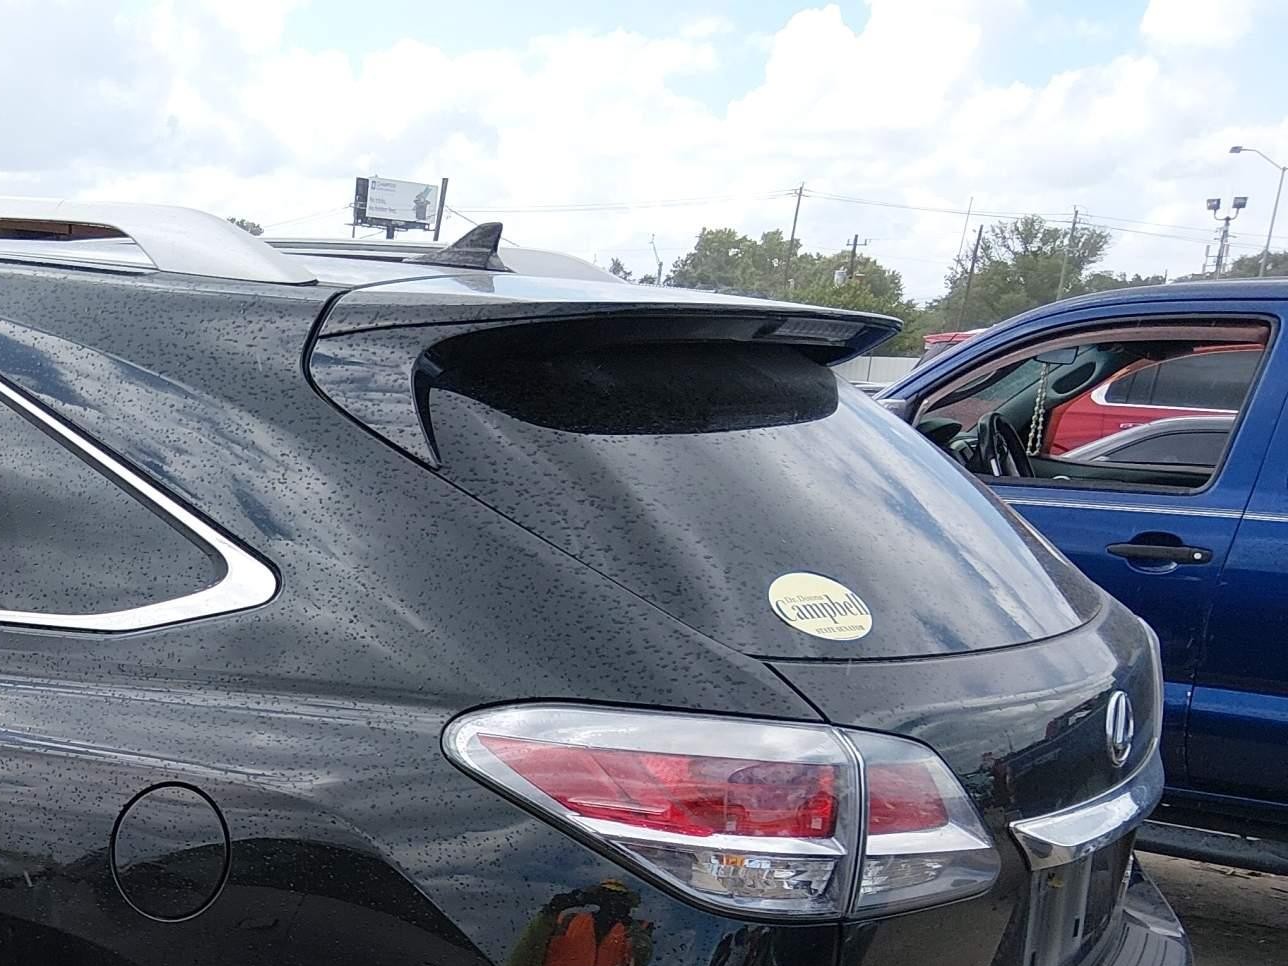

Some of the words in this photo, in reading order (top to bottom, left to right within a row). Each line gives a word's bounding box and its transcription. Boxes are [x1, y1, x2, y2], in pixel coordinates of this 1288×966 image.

[775, 593, 869, 624] Campbell
[816, 626, 837, 635] STATE
[837, 624, 866, 633] SENATOR
